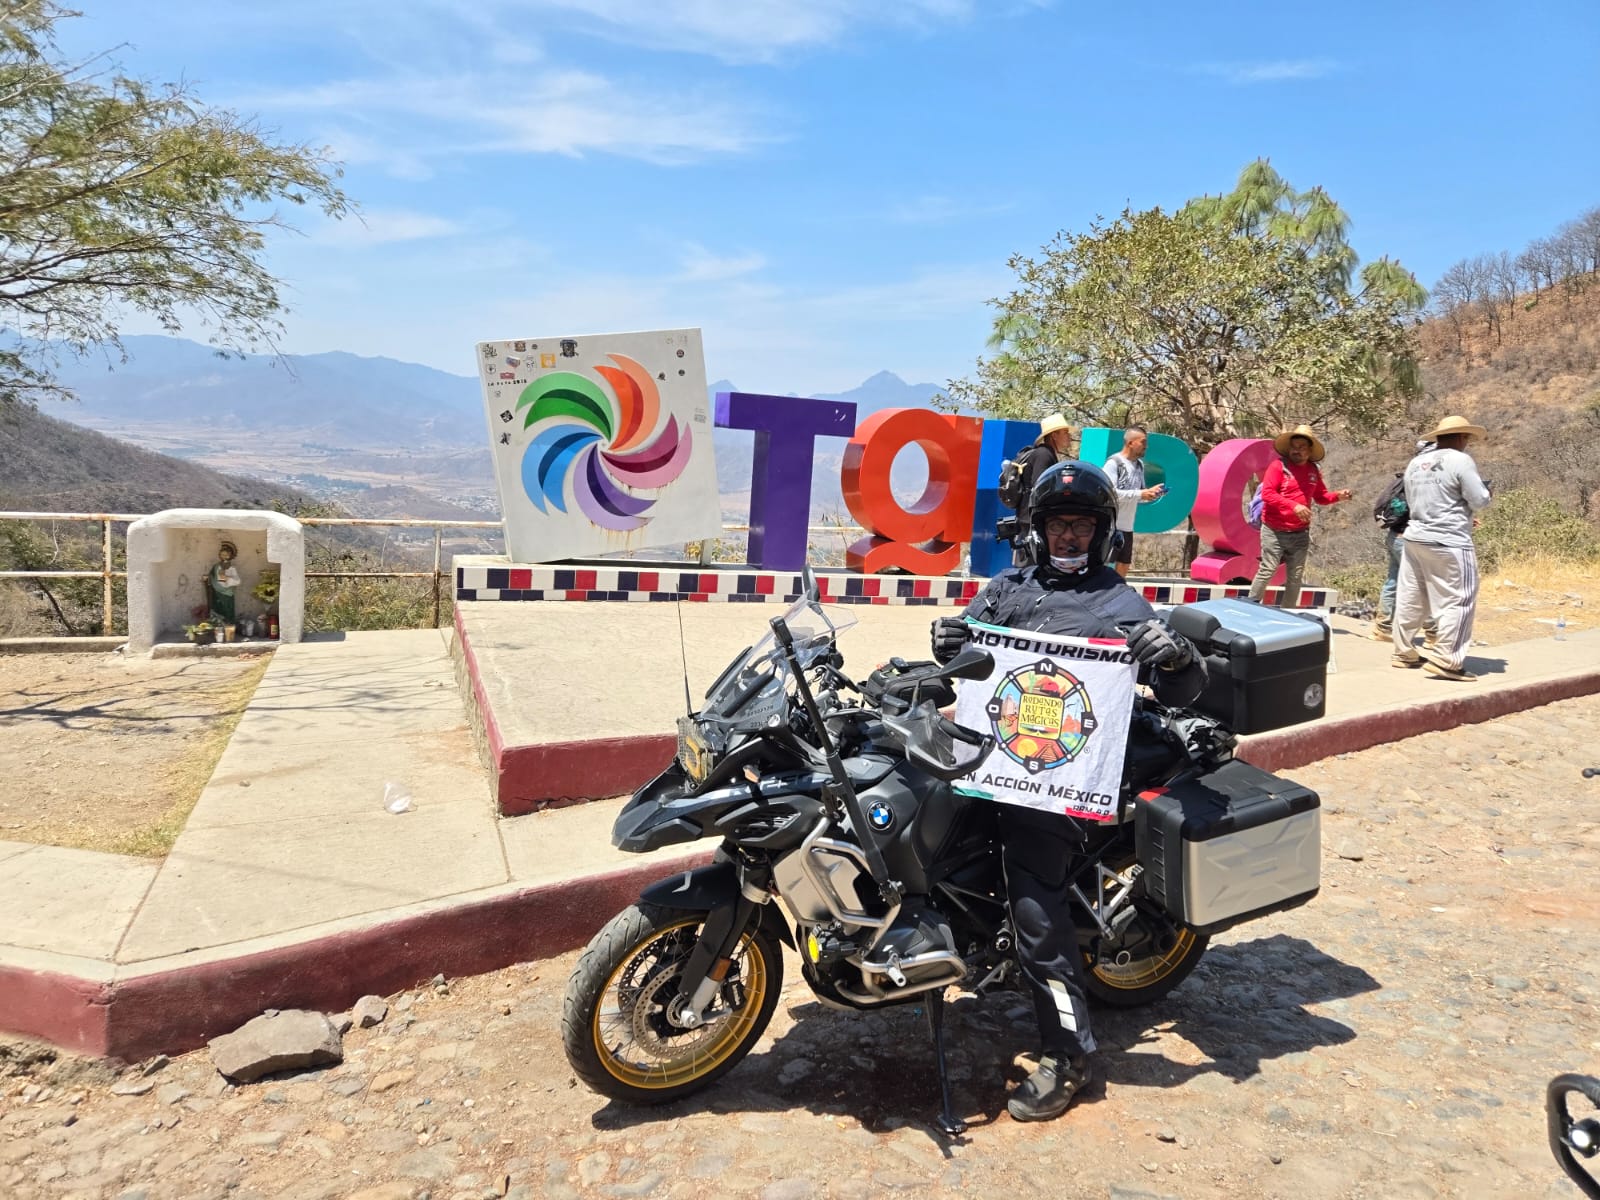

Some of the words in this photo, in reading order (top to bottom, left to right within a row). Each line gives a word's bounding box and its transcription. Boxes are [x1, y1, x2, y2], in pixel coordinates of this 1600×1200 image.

[966, 629, 1136, 665] MOTOTURISMO
[981, 773, 1042, 794] ACCIÓN
[1048, 784, 1113, 806] MÉXICO
